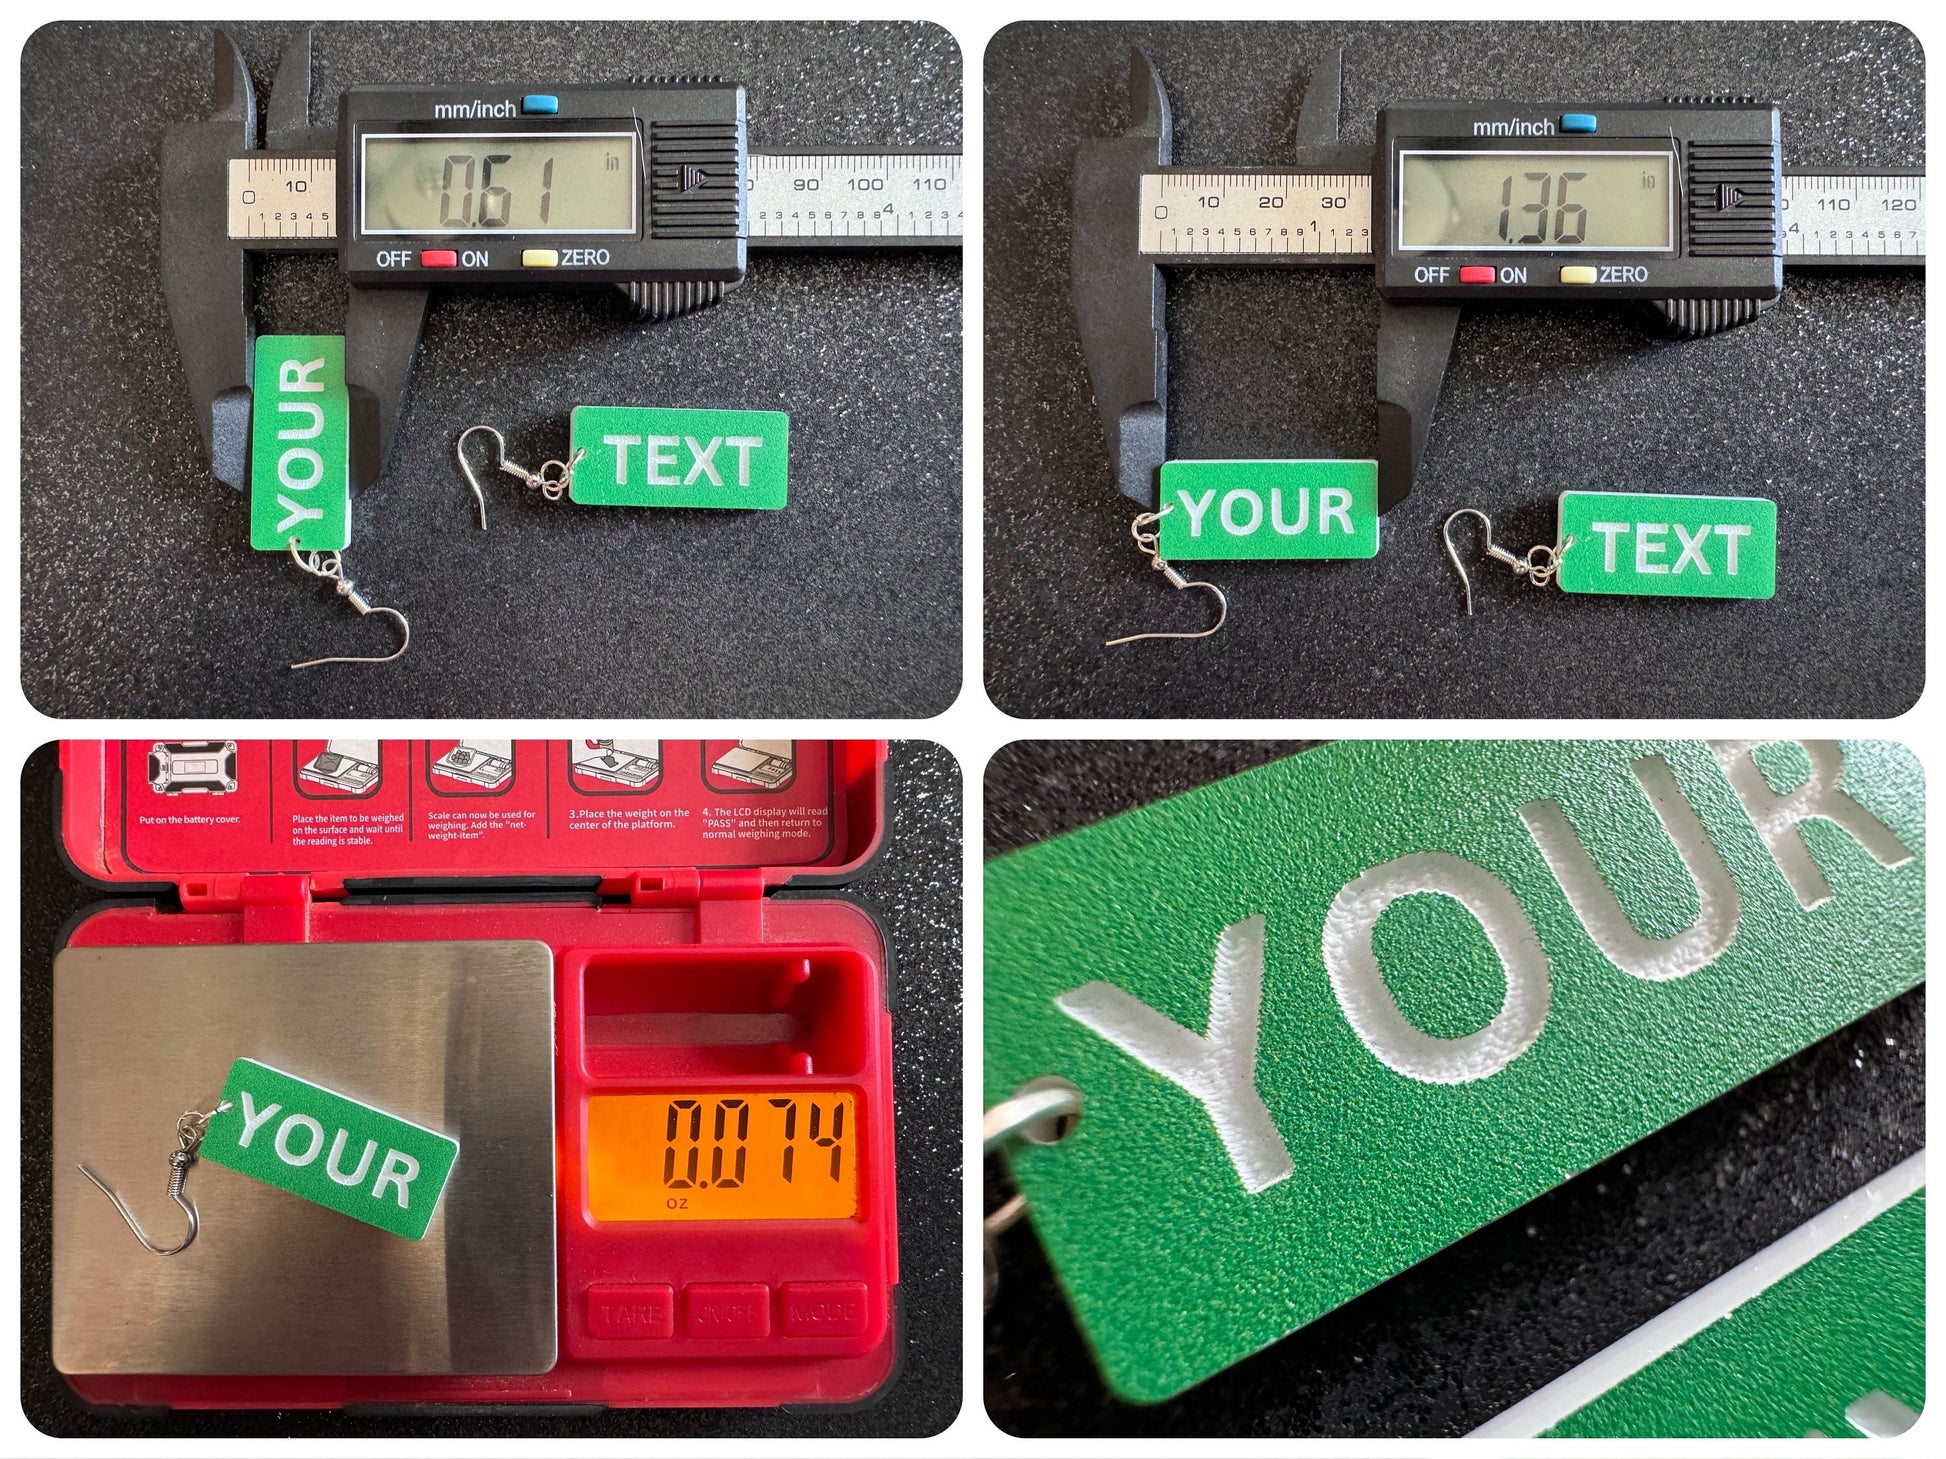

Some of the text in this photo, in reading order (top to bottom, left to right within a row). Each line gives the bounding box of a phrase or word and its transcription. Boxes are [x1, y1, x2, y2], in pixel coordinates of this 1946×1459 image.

[435, 100, 516, 118] mm/inch
[1473, 118, 1555, 136] mm/inch
[605, 152, 619, 170] in
[286, 181, 307, 192] 10
[793, 178, 946, 190] 90 100 110
[1642, 171, 1655, 189] in
[243, 191, 255, 204] 0
[440, 155, 553, 227] 0.61
[883, 203, 894, 214] 4
[1198, 196, 1346, 209] 10 20 30
[1499, 172, 1587, 244] 1.36
[1818, 199, 1916, 211] 110 120
[1155, 206, 1168, 219] 0
[1171, 228, 1176, 236] 1
[1187, 228, 1193, 236] 2
[1202, 228, 1209, 236] 3
[1218, 228, 1225, 236] 4
[1234, 228, 1241, 236] 5
[1249, 228, 1256, 236] 6
[1265, 228, 1271, 236] 7
[1281, 228, 1288, 236] 8
[1296, 228, 1303, 236] 9
[1310, 221, 1317, 232] 1
[1789, 222, 1800, 234] 4
[376, 251, 488, 267] OFF ON
[562, 249, 610, 267] ZERO
[1414, 267, 1527, 283] OFF ON
[1600, 266, 1648, 283] ZERO
[277, 357, 324, 532] YOUR
[603, 434, 763, 487] TEXT
[1177, 487, 1354, 536] YOUR
[1592, 521, 1751, 576] TEXT
[292, 813, 404, 824] Place the item to be weighed
[428, 812, 450, 820] Scale
[489, 811, 500, 819] be
[501, 811, 522, 819] used
[523, 810, 536, 818] for
[569, 809, 605, 818] 3.Place
[607, 809, 622, 818] the
[625, 809, 657, 819] weight
[674, 808, 690, 817] the
[702, 807, 828, 817] 4. The LCD display will read
[139, 816, 154, 824] Put
[168, 816, 183, 824] the
[184, 816, 214, 826] battery
[215, 816, 241, 824] cover.
[428, 822, 469, 831] weighing.
[471, 821, 488, 829] Add
[569, 820, 676, 830] center of the platform.
[703, 819, 736, 827] "PASS"
[738, 819, 756, 827] and
[758, 819, 779, 827] then
[781, 819, 810, 827] return
[304, 826, 318, 834] the
[319, 825, 348, 834] surface
[349, 825, 364, 833] and
[366, 825, 383, 833] wait
[385, 824, 403, 833] until
[702, 829, 811, 840] normal weighing mode.
[292, 836, 373, 847] the reading is stable.
[428, 831, 485, 841] weight-item".
[1055, 739, 1915, 1194] YOUR
[238, 1091, 420, 1209] YOUR
[663, 1100, 844, 1189] 0.074
